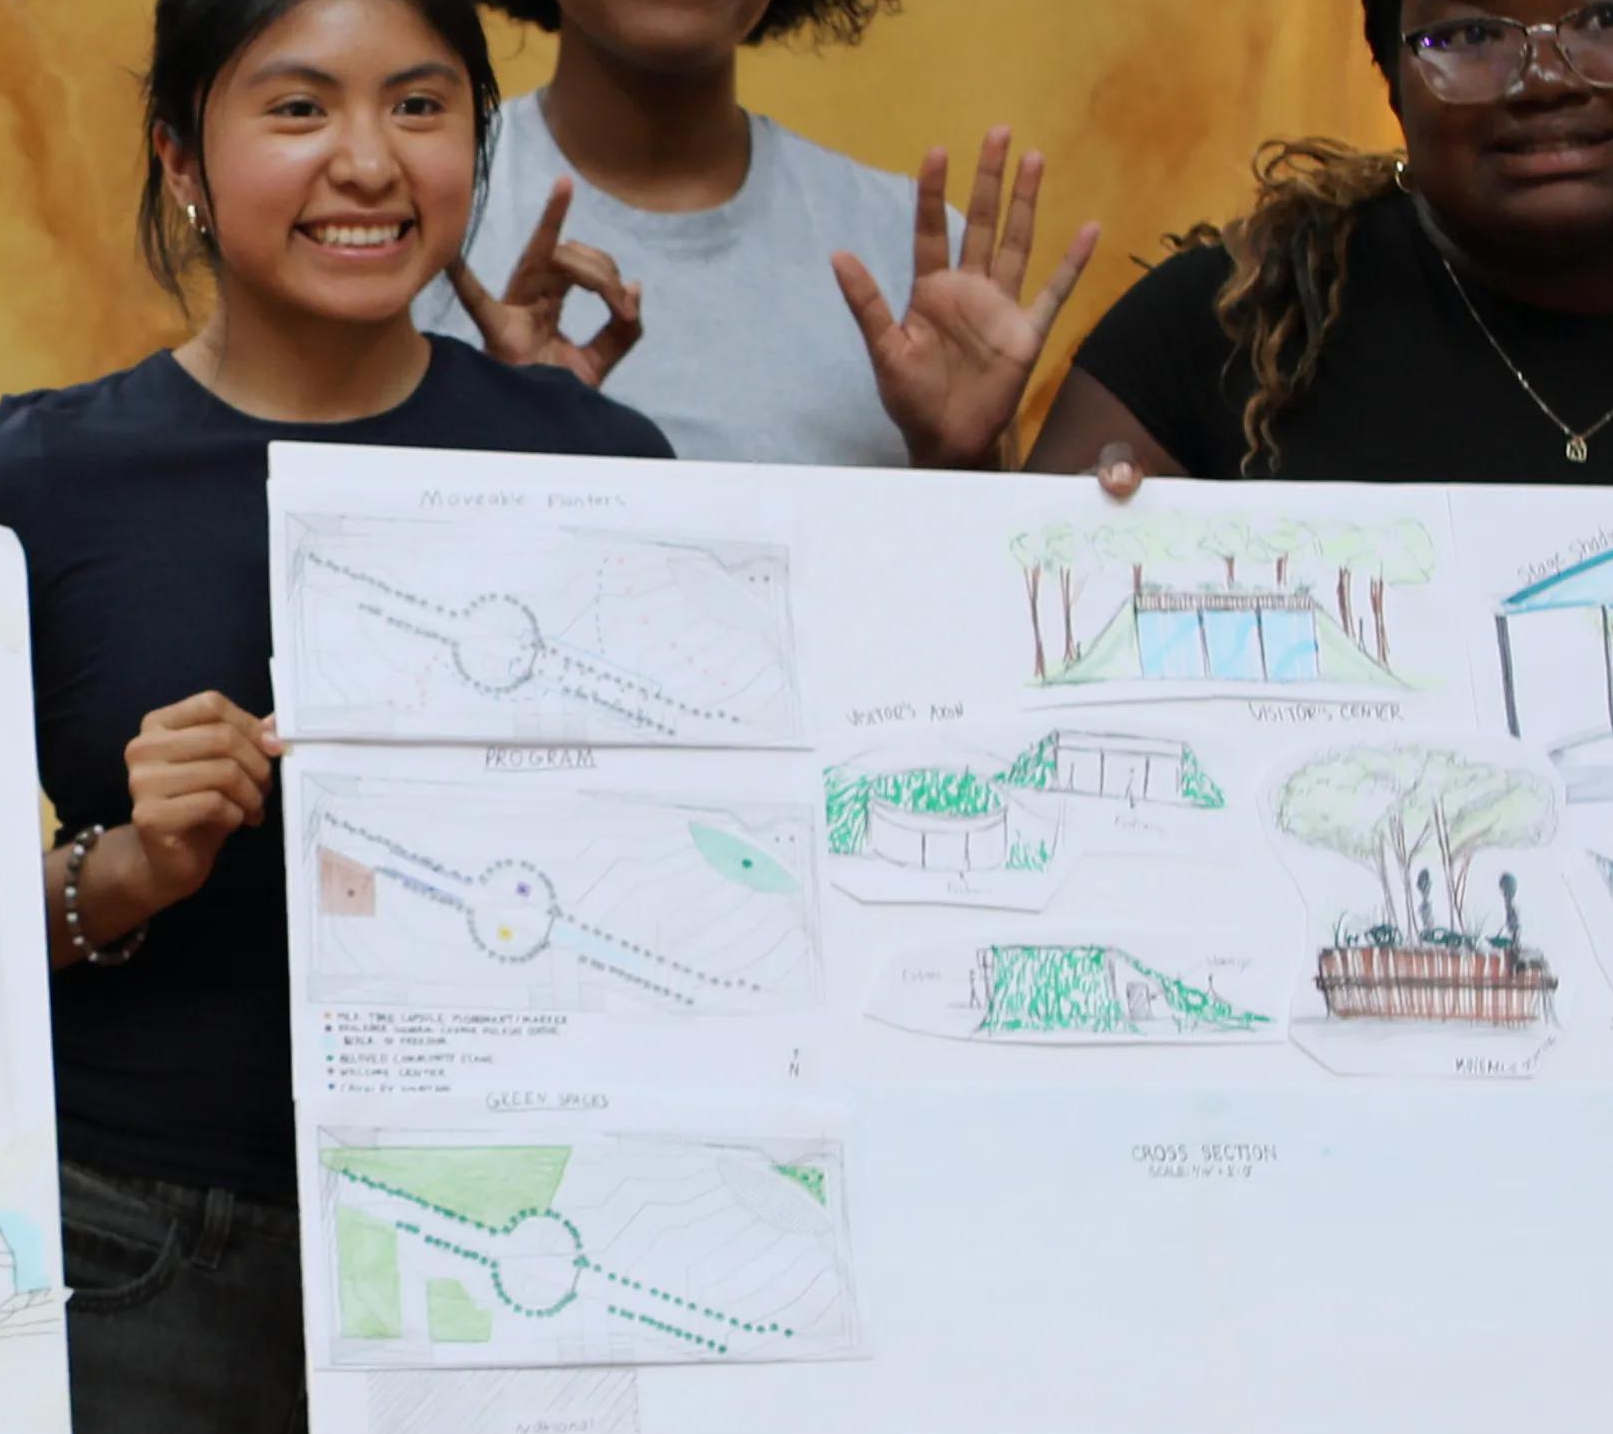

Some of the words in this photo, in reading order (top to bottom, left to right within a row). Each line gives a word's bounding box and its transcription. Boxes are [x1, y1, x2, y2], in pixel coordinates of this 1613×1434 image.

[419, 489, 525, 509] Moveable
[1339, 702, 1404, 723] CENTER
[485, 748, 596, 768] PROGRAM
[486, 1091, 547, 1108] GREEN
[558, 1092, 609, 1108] SPACES
[1131, 1143, 1188, 1163] CROSS
[1201, 1143, 1277, 1162] SECTION
